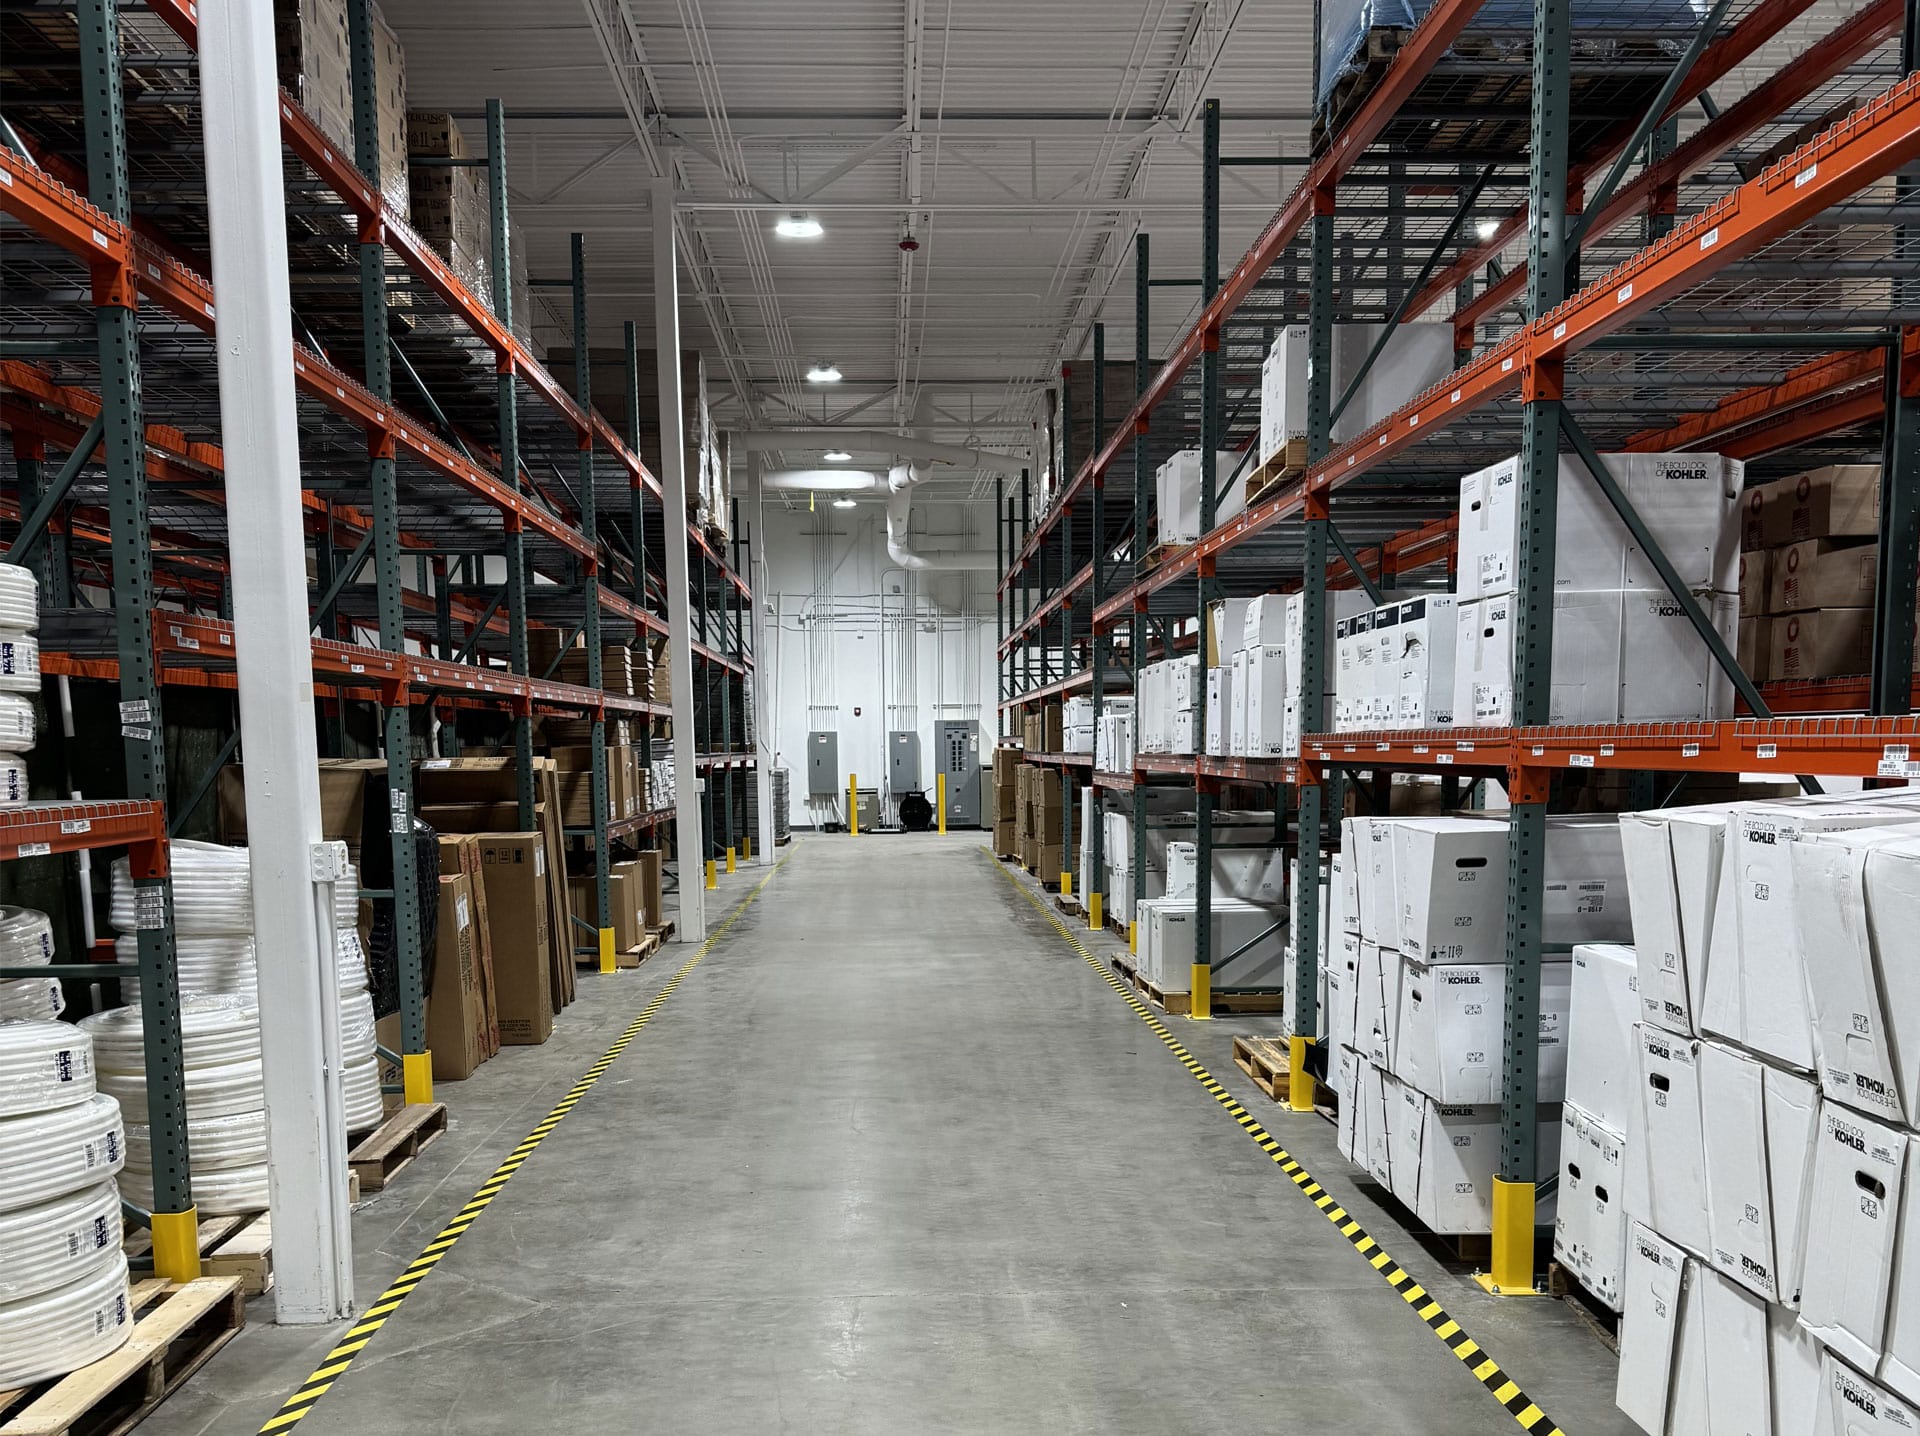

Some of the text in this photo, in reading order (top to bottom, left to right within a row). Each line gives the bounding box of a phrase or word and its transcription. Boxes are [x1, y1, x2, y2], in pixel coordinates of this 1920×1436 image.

[1666, 470, 1707, 480] KOHLER
[1659, 607, 1688, 616] KOHL
[1749, 830, 1776, 845] KOHLER
[1448, 977, 1481, 985] KOHLER
[1855, 1074, 1885, 1096] KOHLER
[1834, 1128, 1865, 1152] KOHLER
[1843, 1386, 1877, 1417] KOHLER
